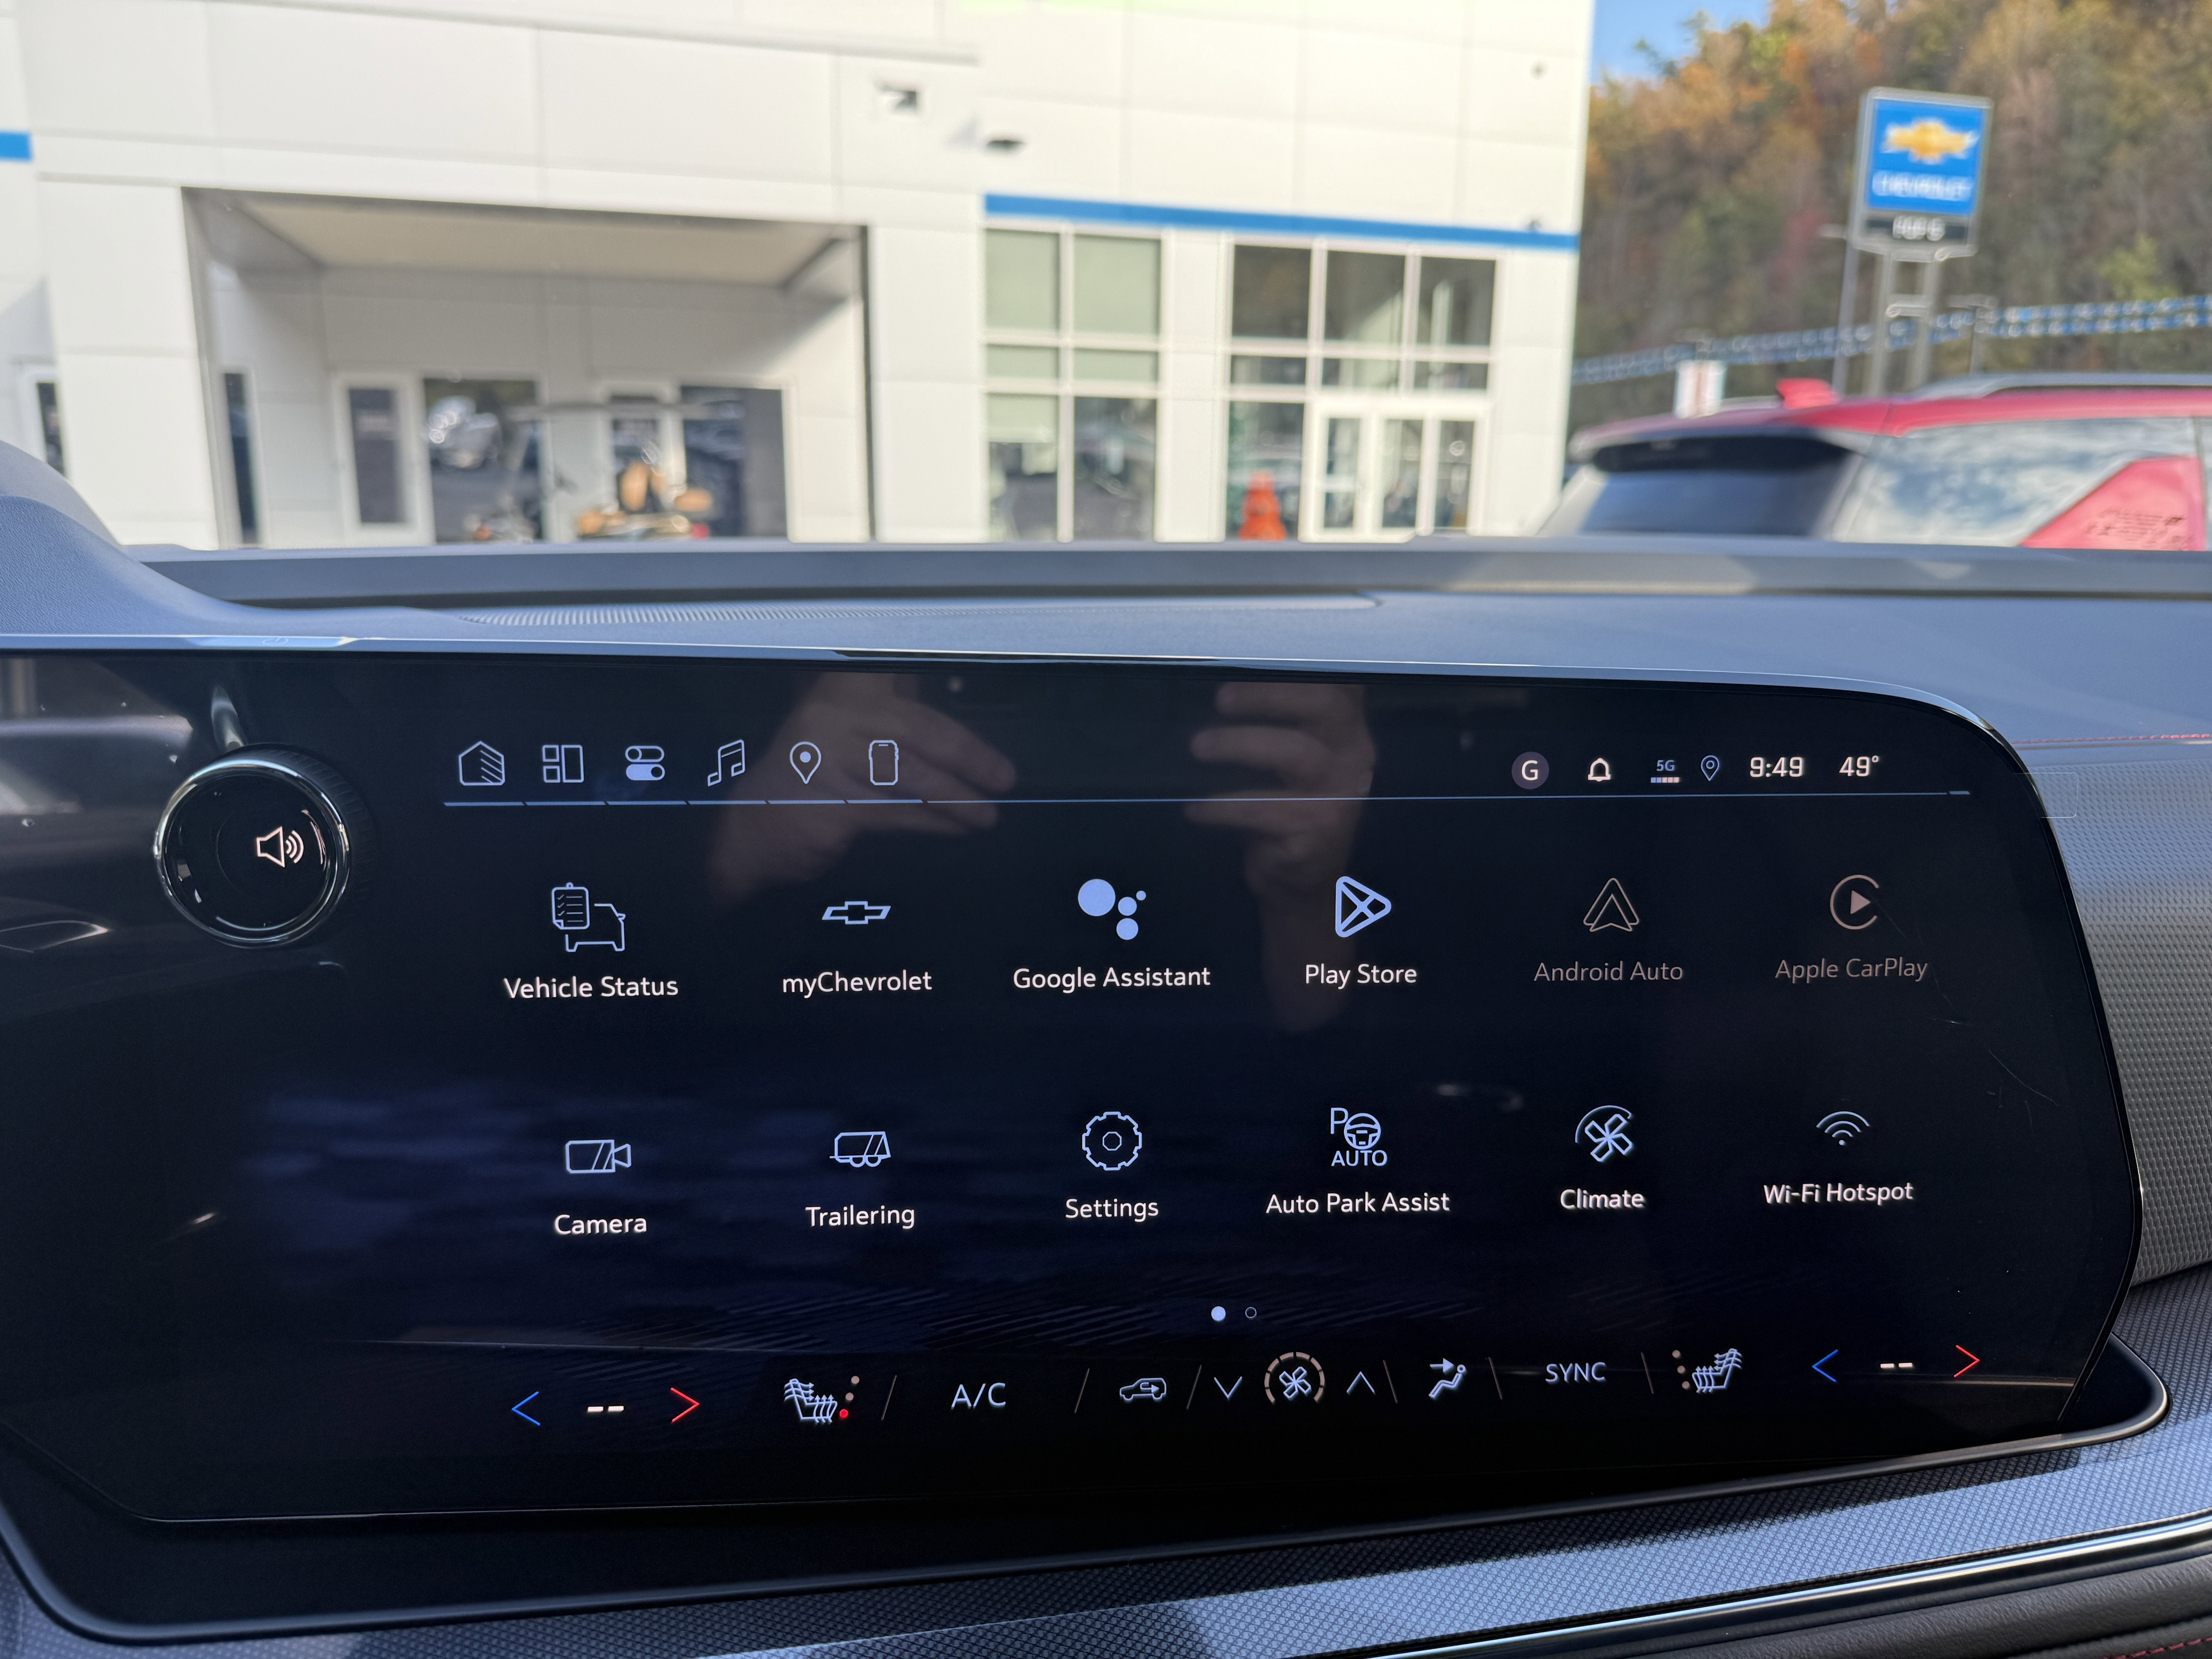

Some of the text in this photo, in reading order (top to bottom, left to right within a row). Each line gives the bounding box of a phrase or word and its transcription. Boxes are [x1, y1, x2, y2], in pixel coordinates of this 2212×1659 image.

[1521, 759, 1539, 781] G
[1656, 759, 1675, 772] 5G
[1749, 756, 1804, 778] 9:49
[1838, 755, 1879, 777] 49°
[1013, 966, 1211, 994] Google Assistant
[1305, 963, 1417, 990] Play Store
[1533, 960, 1683, 982] Android Auto
[1774, 956, 1928, 984] Apple CarPlay
[503, 975, 679, 999] Vehicle Status
[783, 969, 933, 999] myChevrolet
[1331, 1149, 1388, 1167] AUTO
[1266, 1191, 1450, 1214] Auto Park Assist
[1560, 1188, 1645, 1210] Climate
[1763, 1182, 1913, 1206] Wi-Fi Hotspot
[805, 1204, 915, 1230] Trailering
[1065, 1198, 1159, 1223] Settings
[554, 1214, 647, 1235] Camera
[1545, 1361, 1606, 1383] SYNC
[951, 1382, 1006, 1409] A/C
